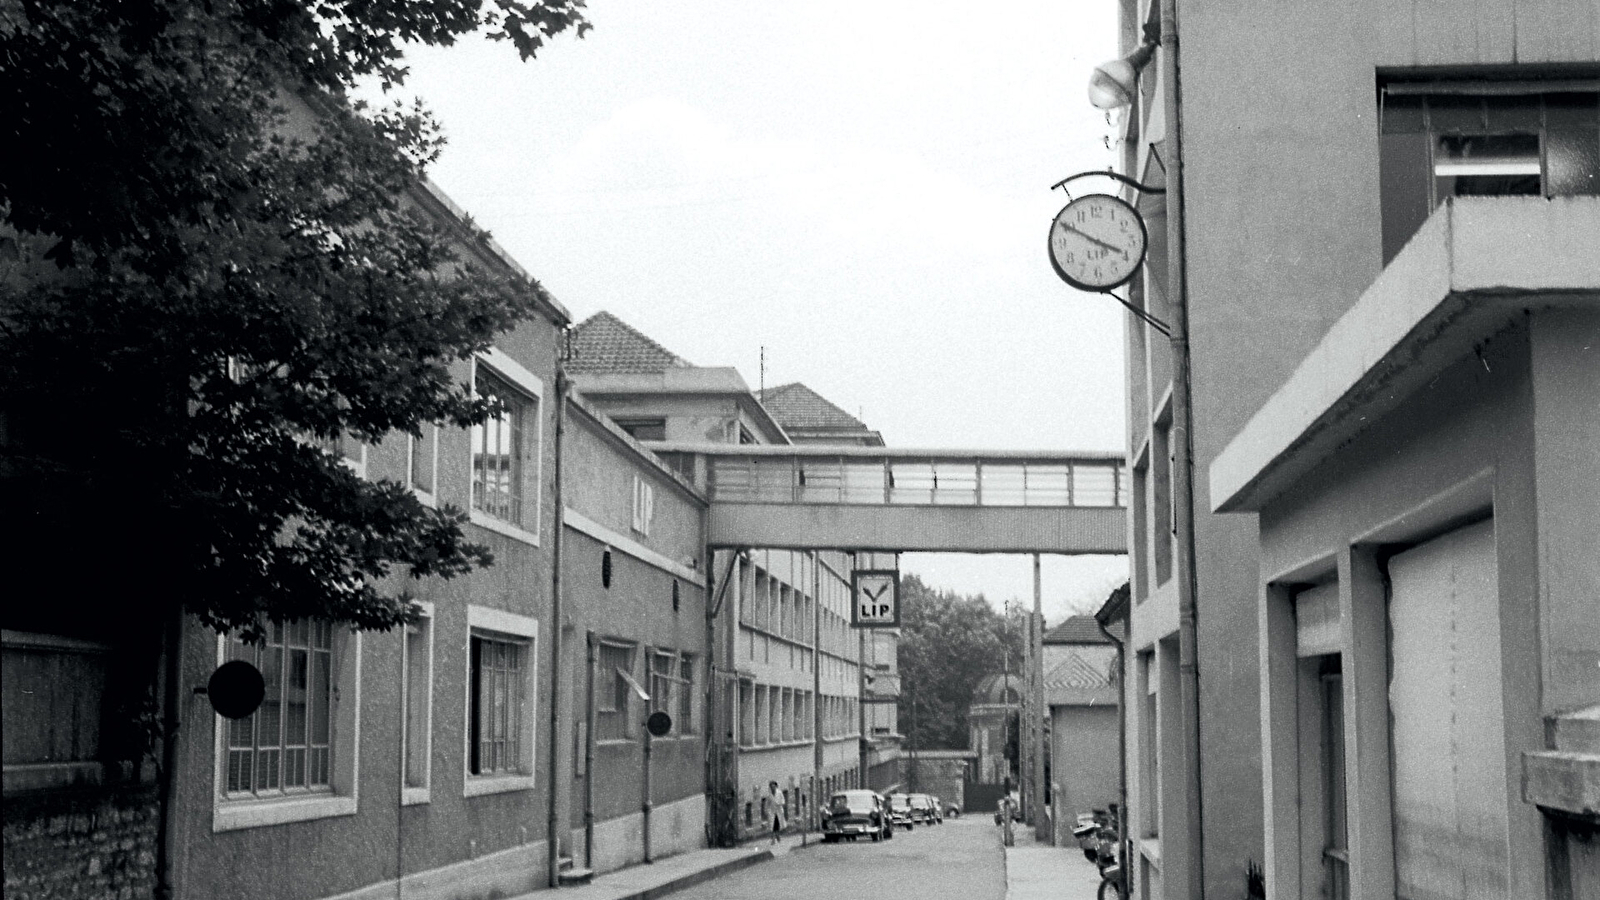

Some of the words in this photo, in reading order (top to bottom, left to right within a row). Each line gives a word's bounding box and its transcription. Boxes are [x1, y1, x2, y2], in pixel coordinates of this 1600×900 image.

[1077, 210, 1085, 223] 11
[1090, 205, 1103, 219] 12
[1120, 220, 1129, 233] 2
[1059, 237, 1067, 250] 9
[1066, 252, 1075, 265] 8
[1087, 249, 1109, 260] LIP
[1094, 266, 1103, 279] 6
[633, 476, 653, 536] LIP
[861, 604, 890, 617] LIP
